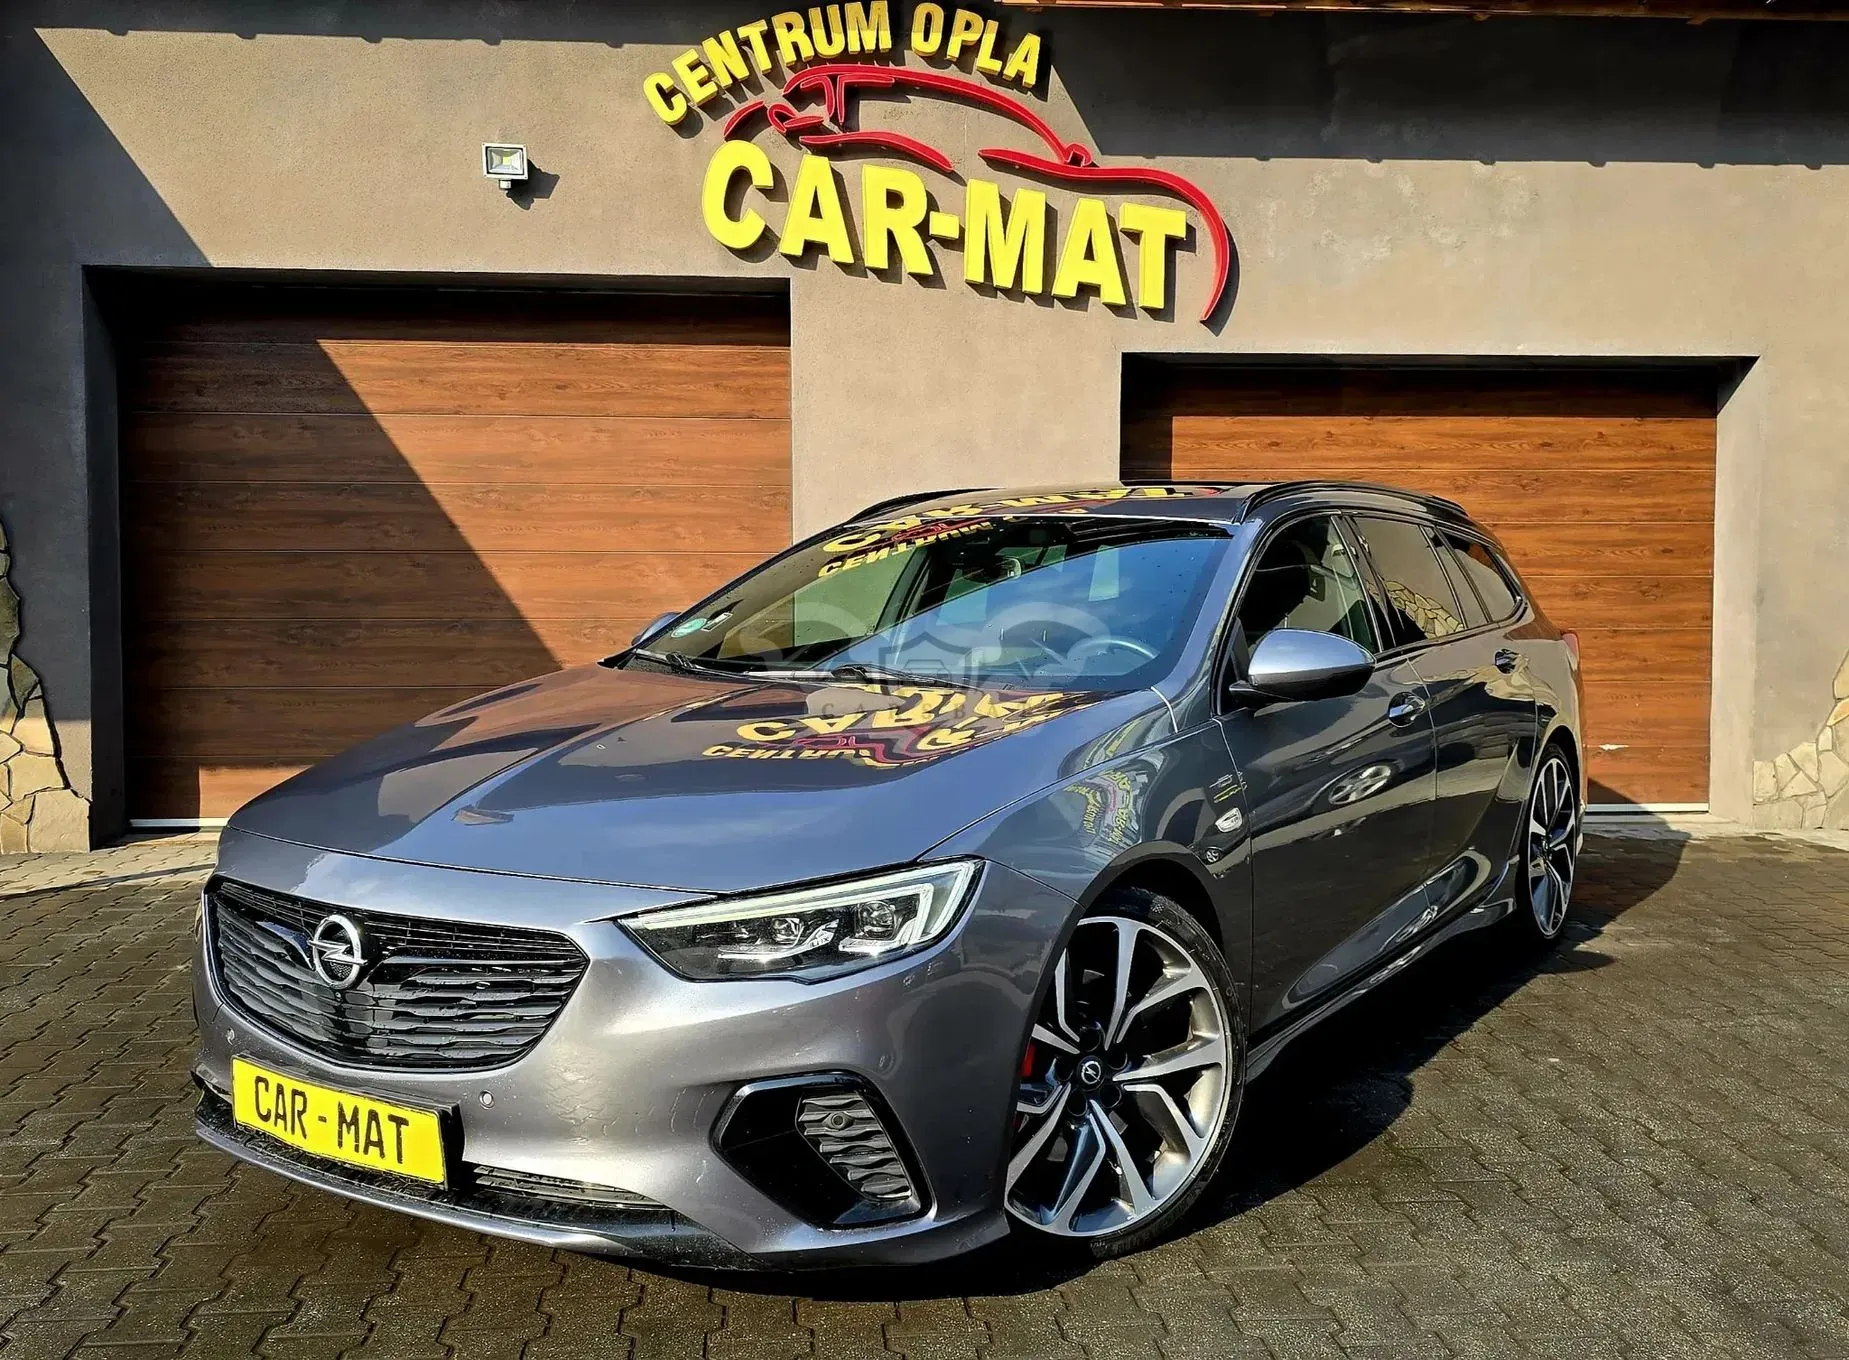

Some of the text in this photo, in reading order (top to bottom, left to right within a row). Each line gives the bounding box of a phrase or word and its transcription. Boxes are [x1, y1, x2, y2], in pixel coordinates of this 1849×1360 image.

[643, 0, 1041, 125] CENTRUM OPLA
[703, 139, 1187, 310] CAR-MAT
[255, 1077, 307, 1139] CAR
[339, 1101, 410, 1165] MAT
